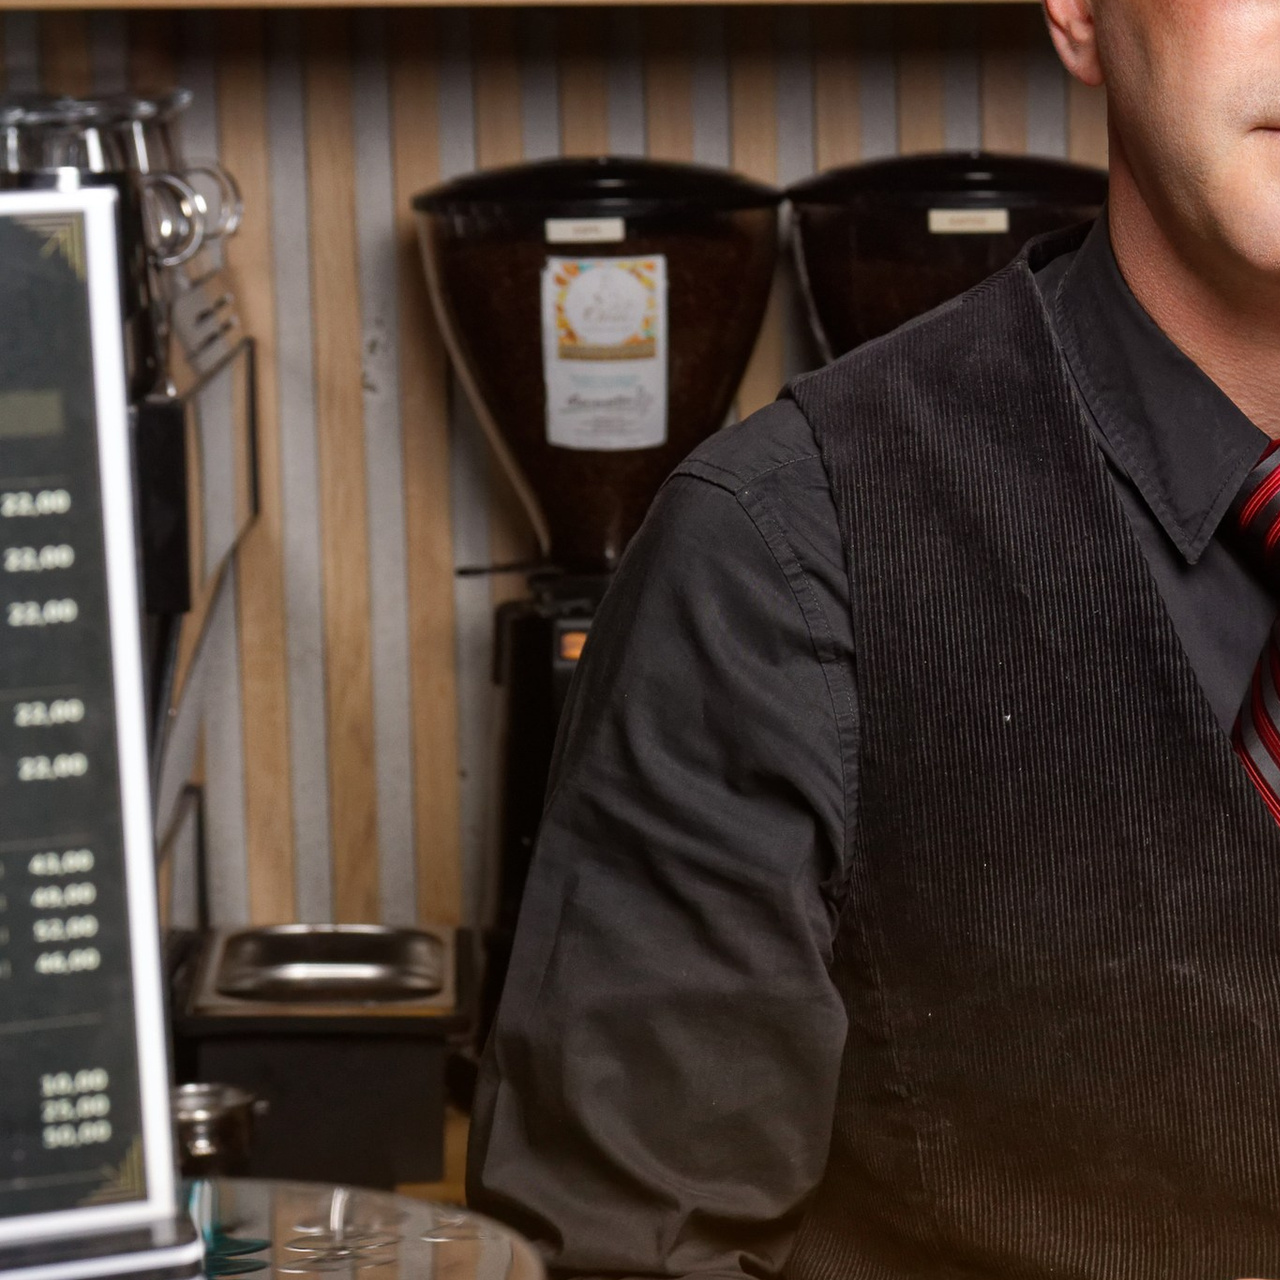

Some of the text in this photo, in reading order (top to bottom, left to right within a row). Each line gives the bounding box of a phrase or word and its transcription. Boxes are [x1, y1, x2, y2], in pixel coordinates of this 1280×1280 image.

[41, 1068, 109, 1097] 10,00
[42, 1094, 111, 1123] 25,00
[43, 1119, 112, 1150] 50,00
